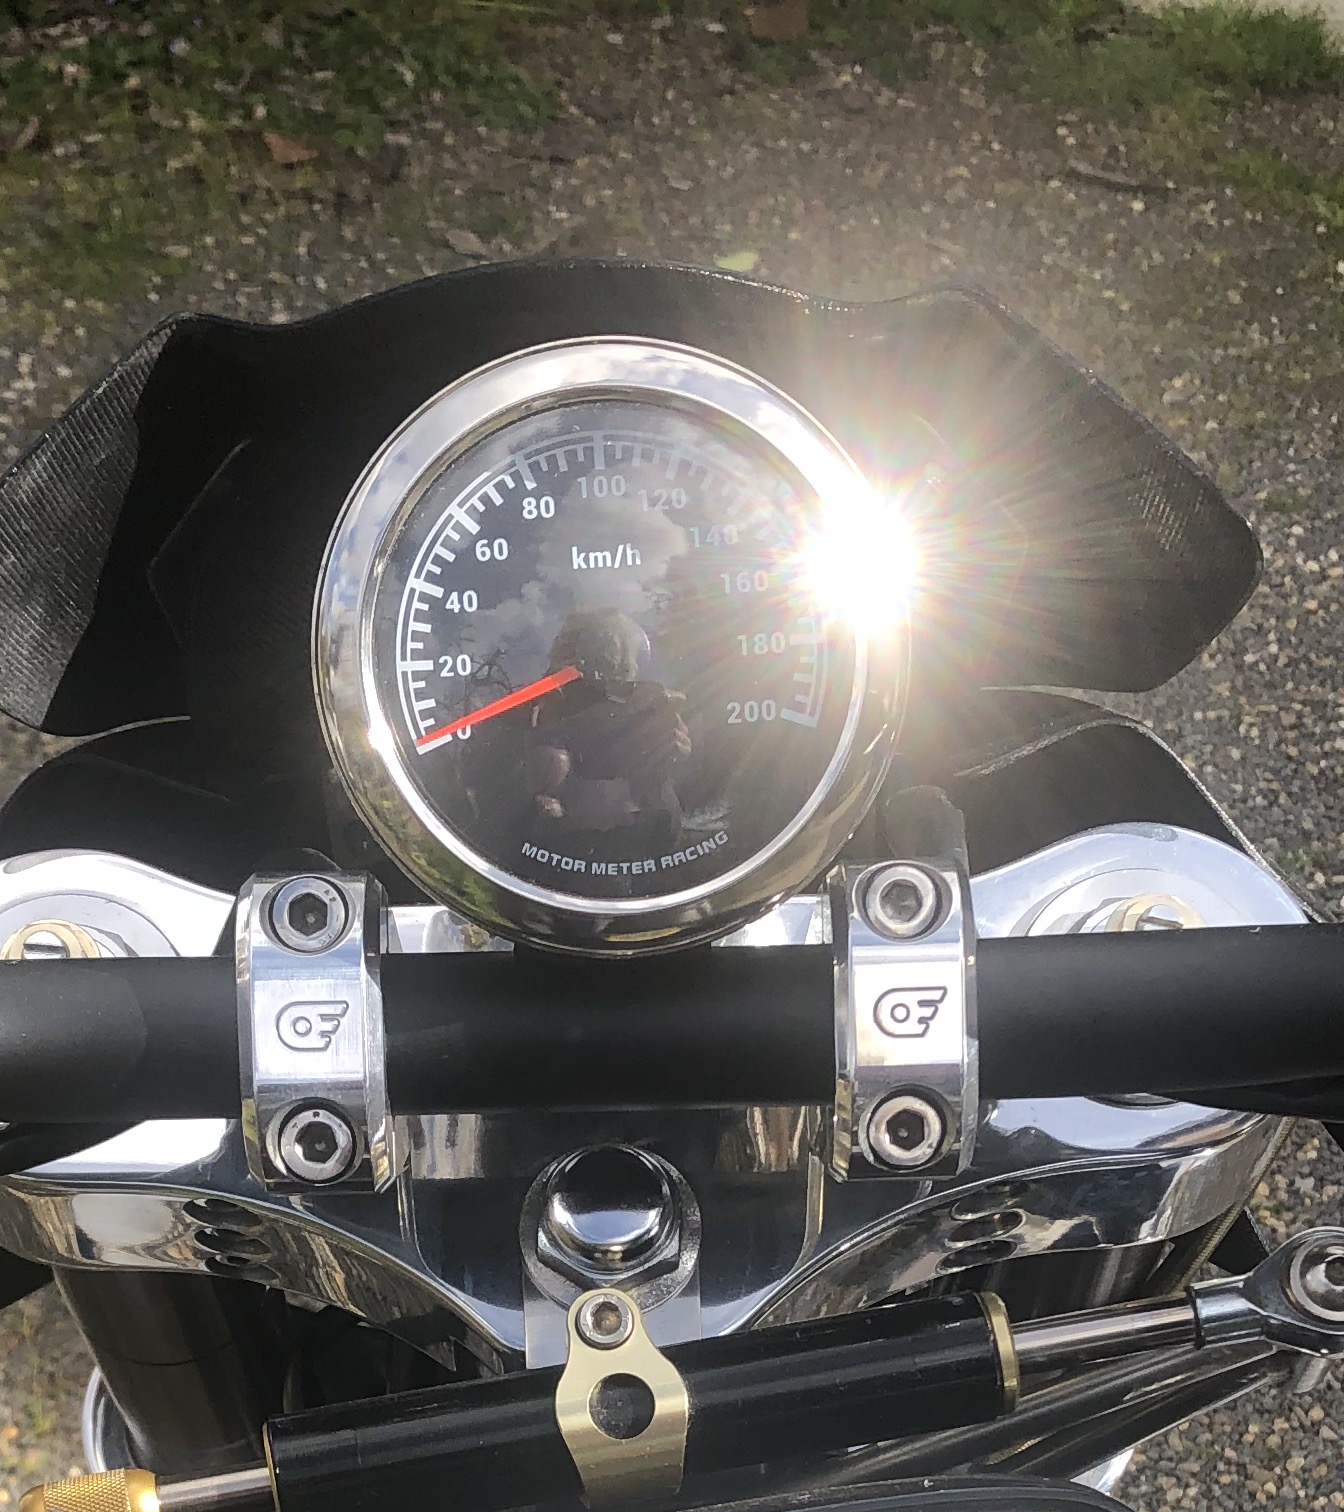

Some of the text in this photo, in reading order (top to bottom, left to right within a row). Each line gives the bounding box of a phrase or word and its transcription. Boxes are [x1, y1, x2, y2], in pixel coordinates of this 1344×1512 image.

[577, 475, 626, 498] 100
[522, 496, 555, 519] 80
[638, 487, 686, 512] 120
[689, 524, 738, 548] 140
[475, 538, 508, 562] 60
[571, 543, 642, 569] km/h
[720, 570, 768, 594] 160
[445, 590, 478, 613] 40
[737, 632, 785, 656] 180
[438, 654, 472, 677] 20
[726, 699, 776, 724] 200
[521, 830, 729, 876] MOTOR METER RACING
